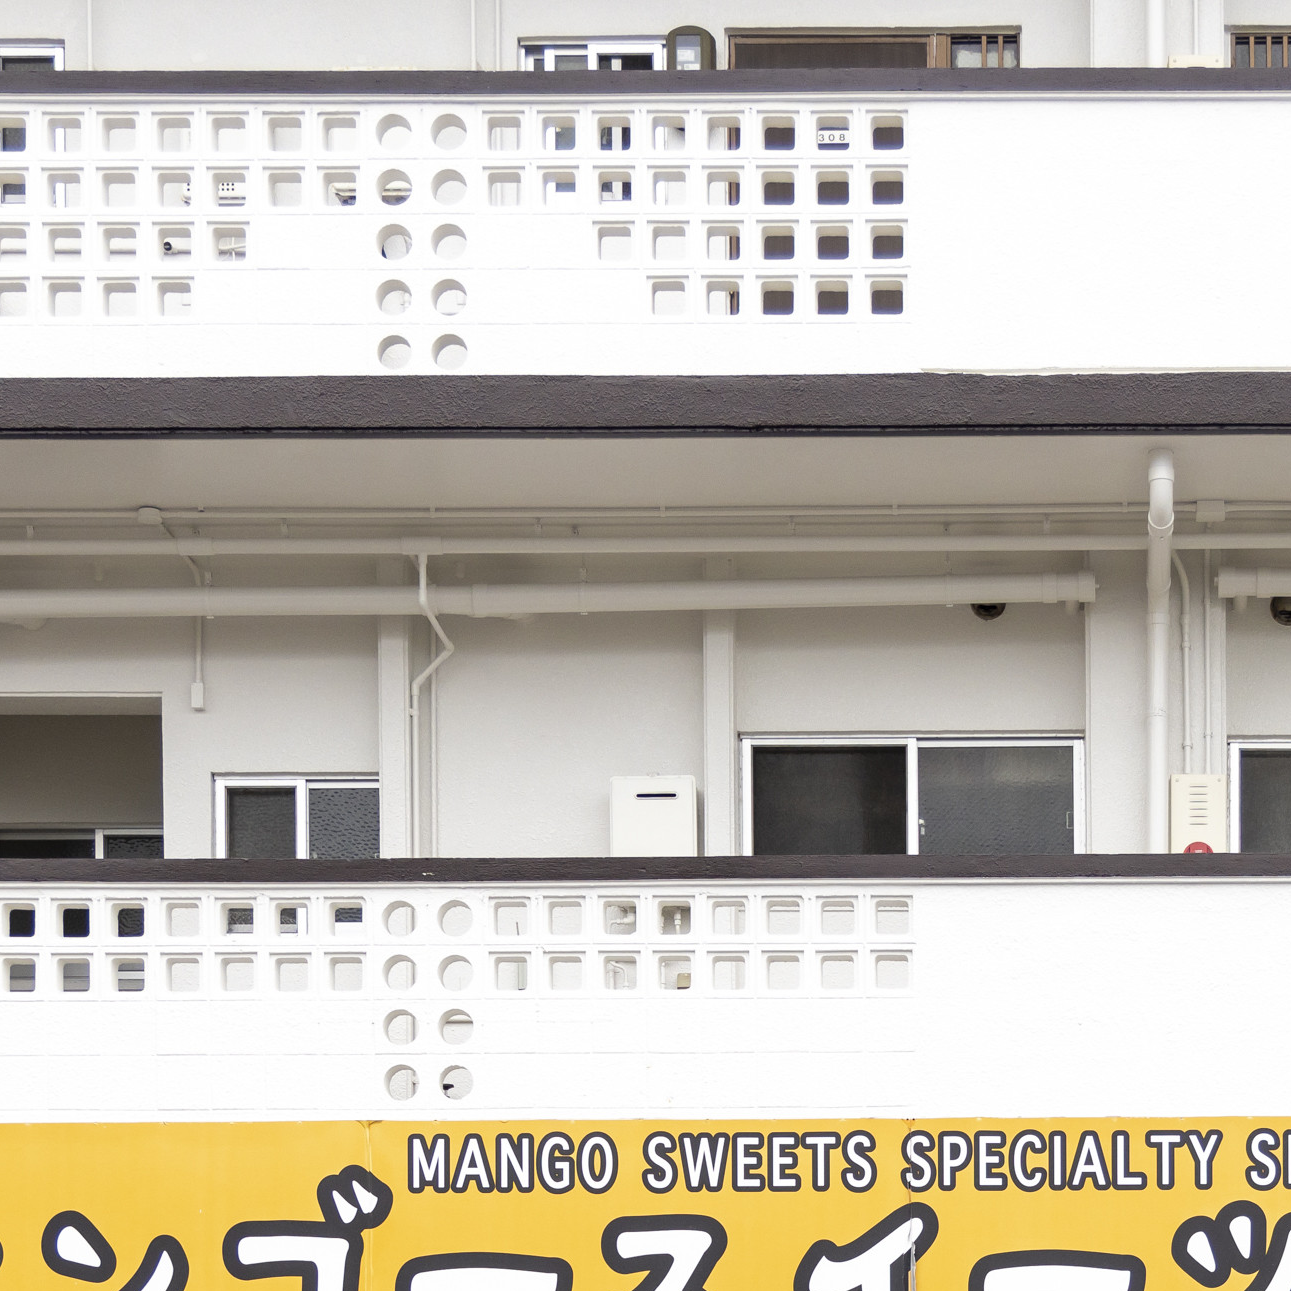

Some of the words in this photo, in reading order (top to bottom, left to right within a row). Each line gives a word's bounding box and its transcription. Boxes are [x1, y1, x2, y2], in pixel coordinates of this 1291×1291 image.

[818, 133, 846, 142] 308
[407, 1131, 618, 1195] MANGO
[642, 1131, 878, 1194] SWEETS
[900, 1129, 1222, 1193] SPECIALTY
